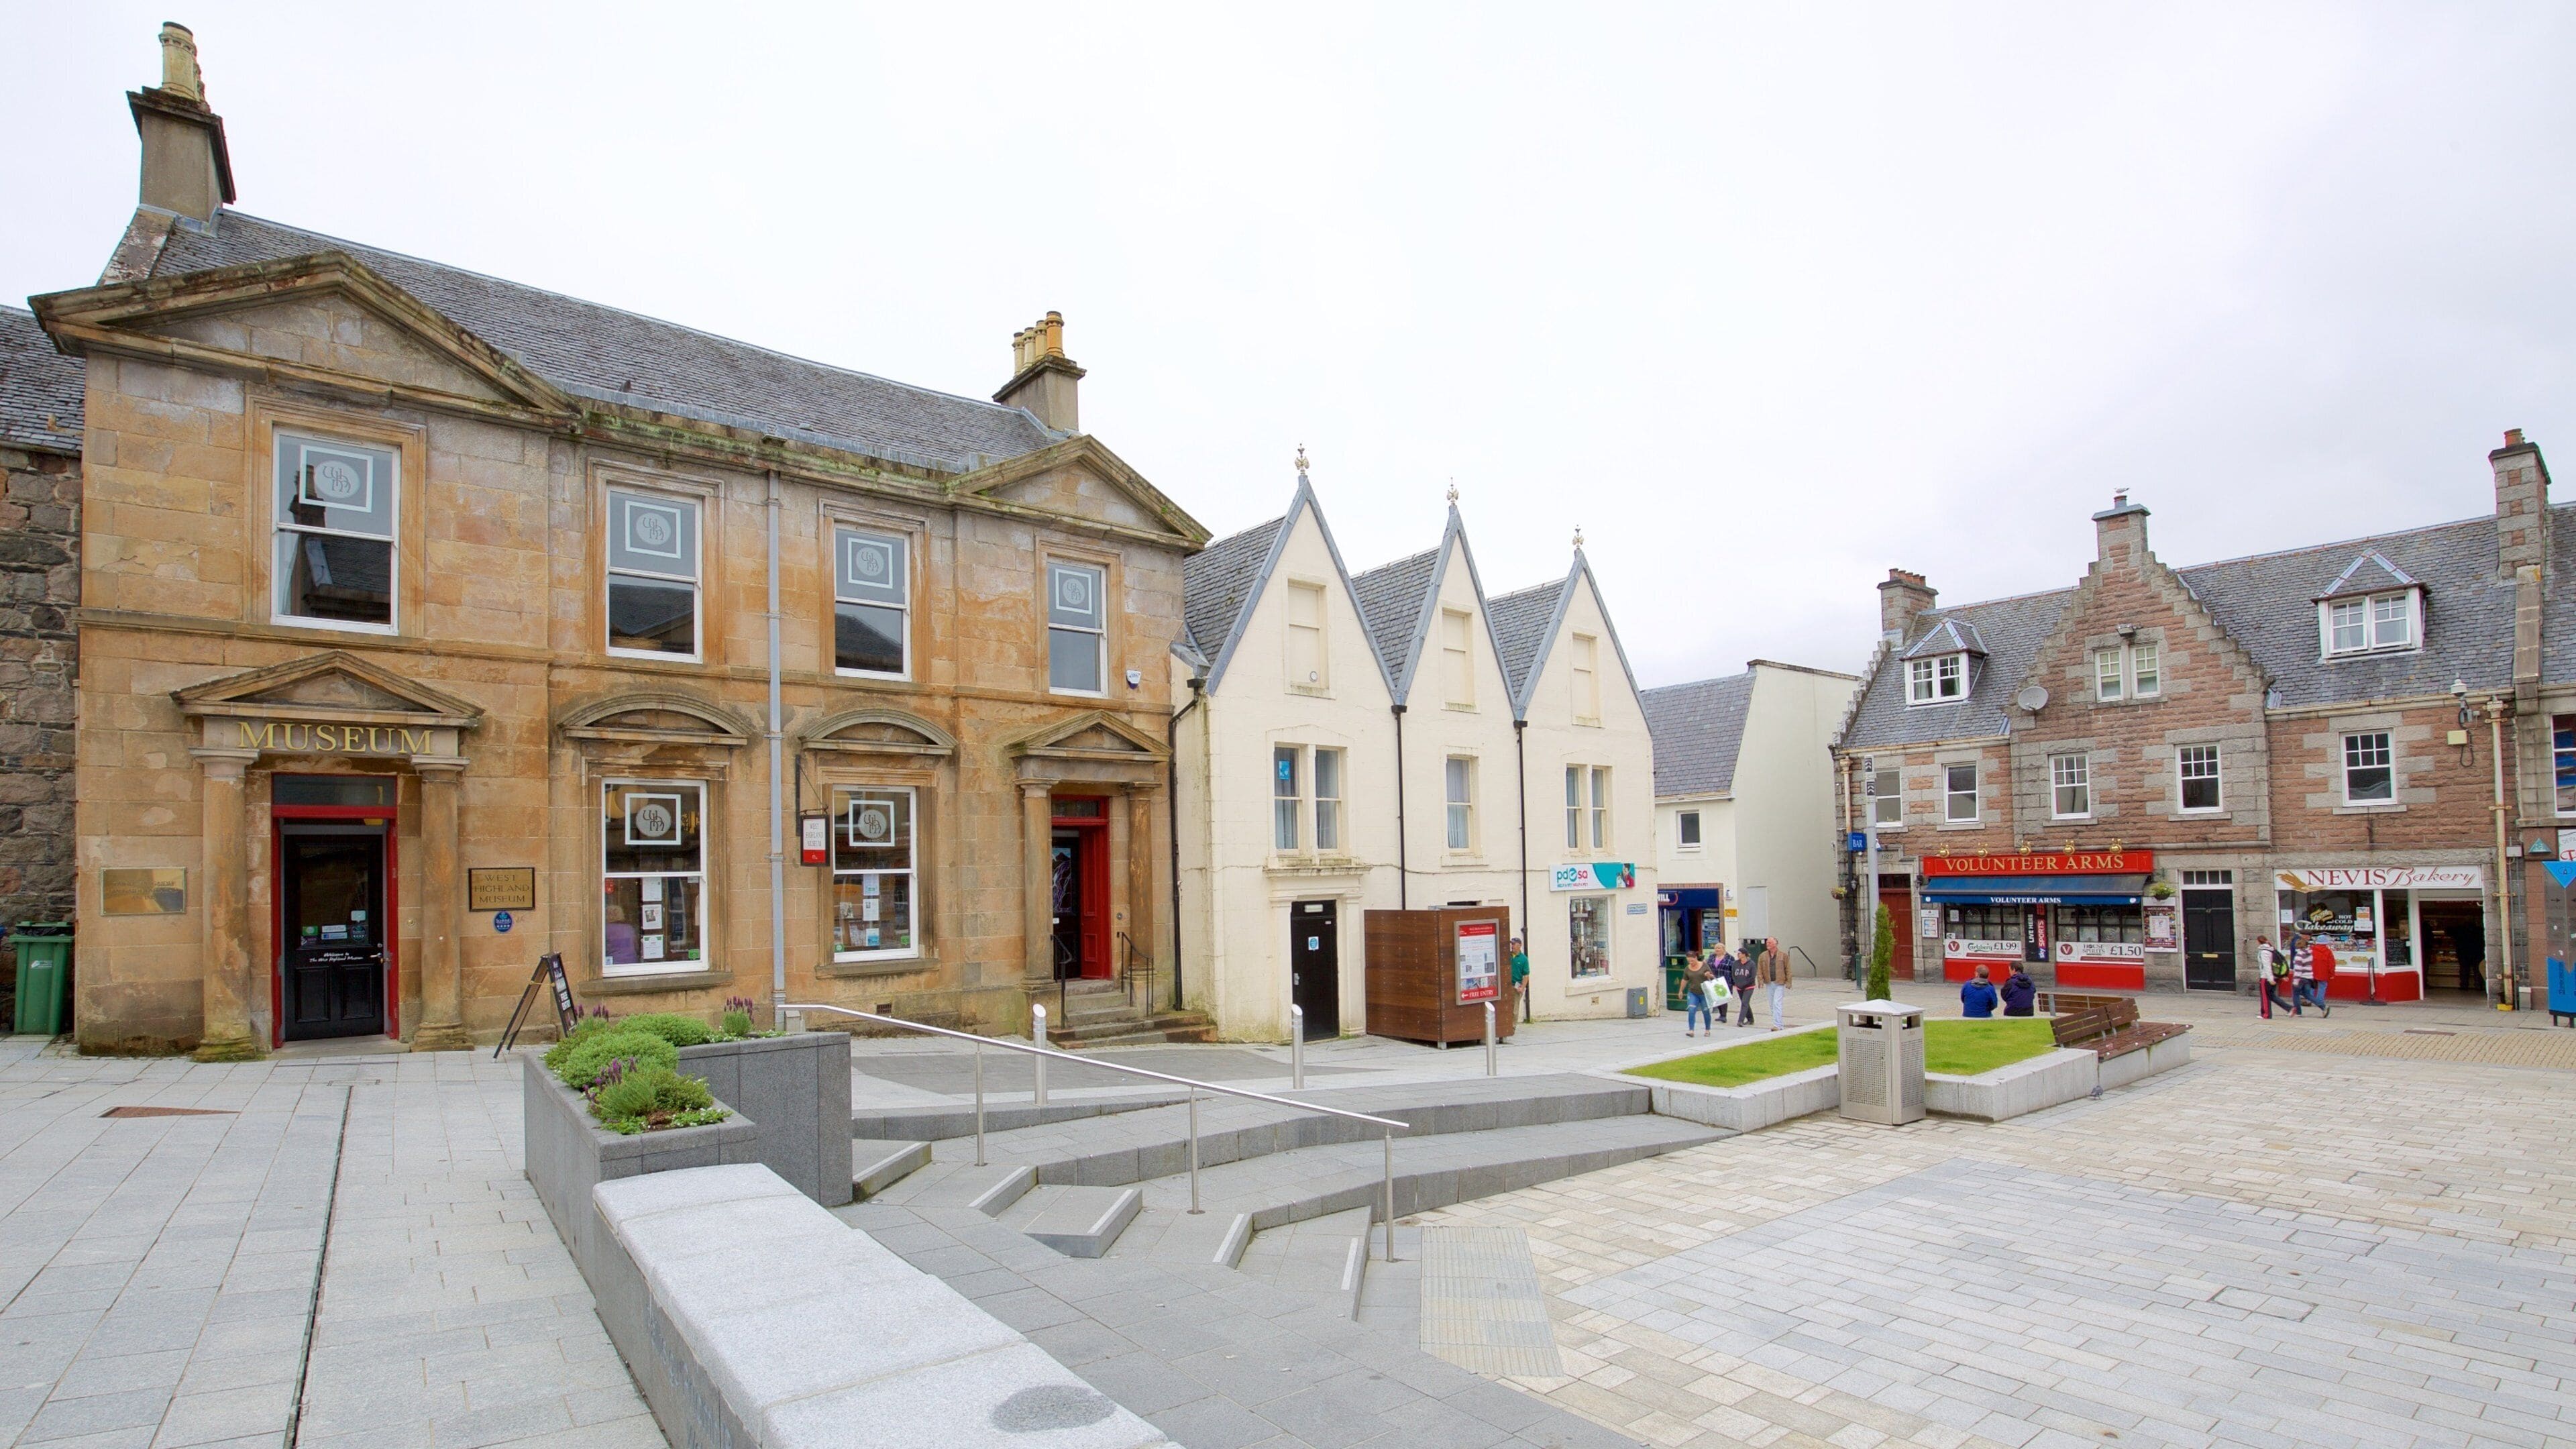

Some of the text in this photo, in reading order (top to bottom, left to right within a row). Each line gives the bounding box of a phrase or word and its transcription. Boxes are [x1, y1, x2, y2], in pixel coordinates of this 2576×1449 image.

[238, 722, 434, 754] MUSEUM
[1852, 839, 1863, 848] BAR
[1946, 855, 2125, 872] VOLUNTEER ARMS
[2307, 865, 2477, 886] NEVIS Bakery
[474, 884, 529, 892] HIGHLAND
[480, 895, 525, 903] MUSEUM
[2294, 920, 2354, 932] Takeaway
[2037, 920, 2045, 947] SPORTS
[1967, 942, 2017, 951] Carlsberg £1.99
[2110, 946, 2142, 956] £1.50
[1735, 969, 1750, 977] GAP
[1480, 989, 1494, 997] ENTRY
